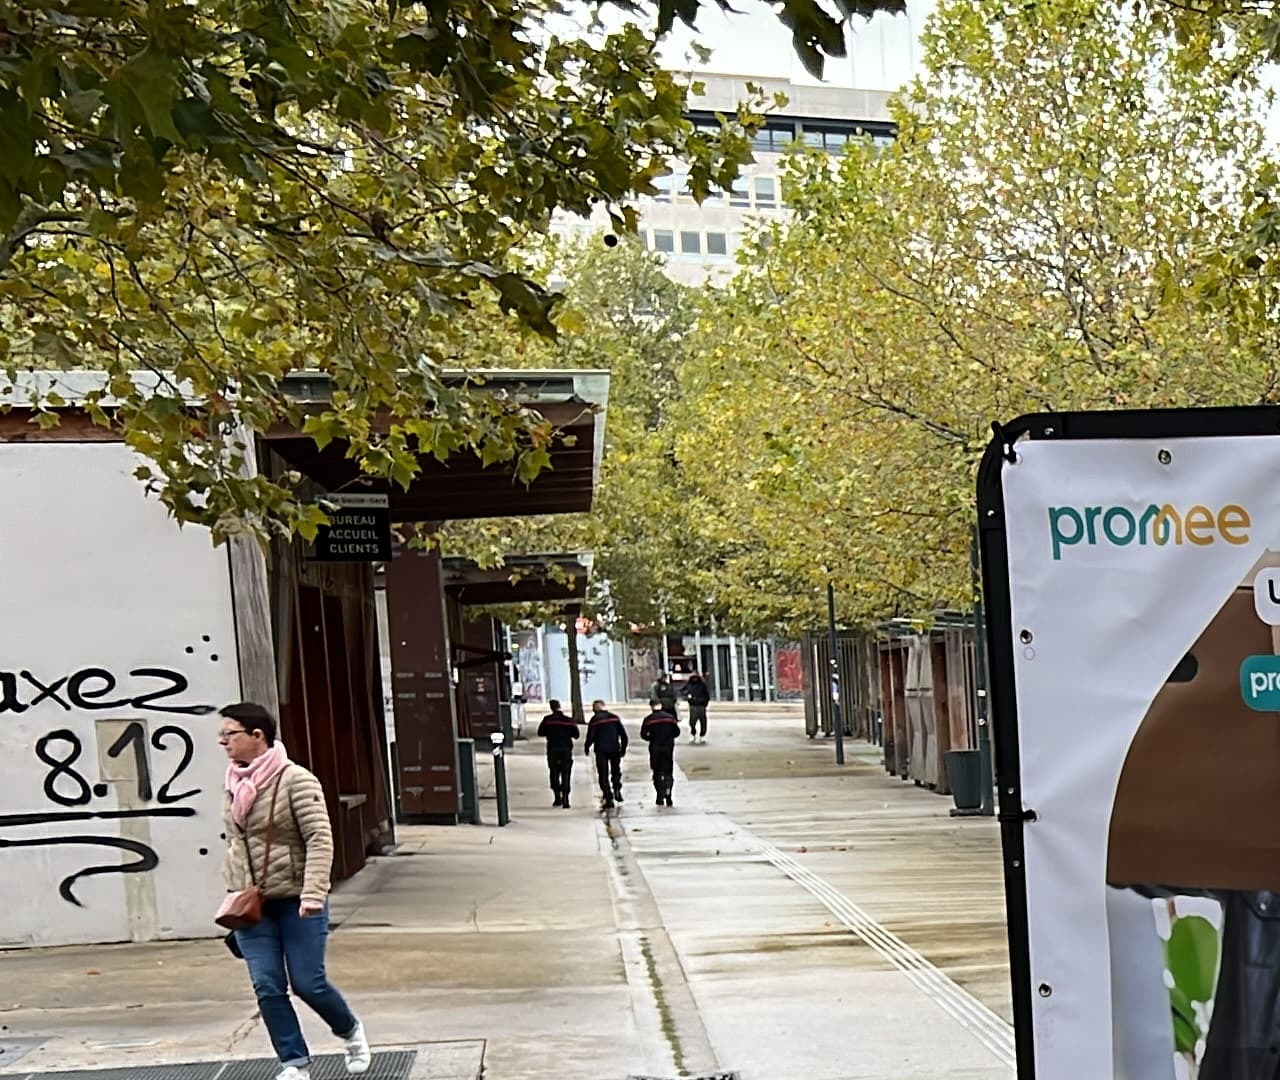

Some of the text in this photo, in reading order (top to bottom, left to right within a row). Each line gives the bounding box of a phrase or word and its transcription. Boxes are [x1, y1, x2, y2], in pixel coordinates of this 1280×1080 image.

[328, 529, 380, 540] ACCUEIL
[1048, 504, 1251, 561] promee
[329, 543, 380, 555] CLIENTS
